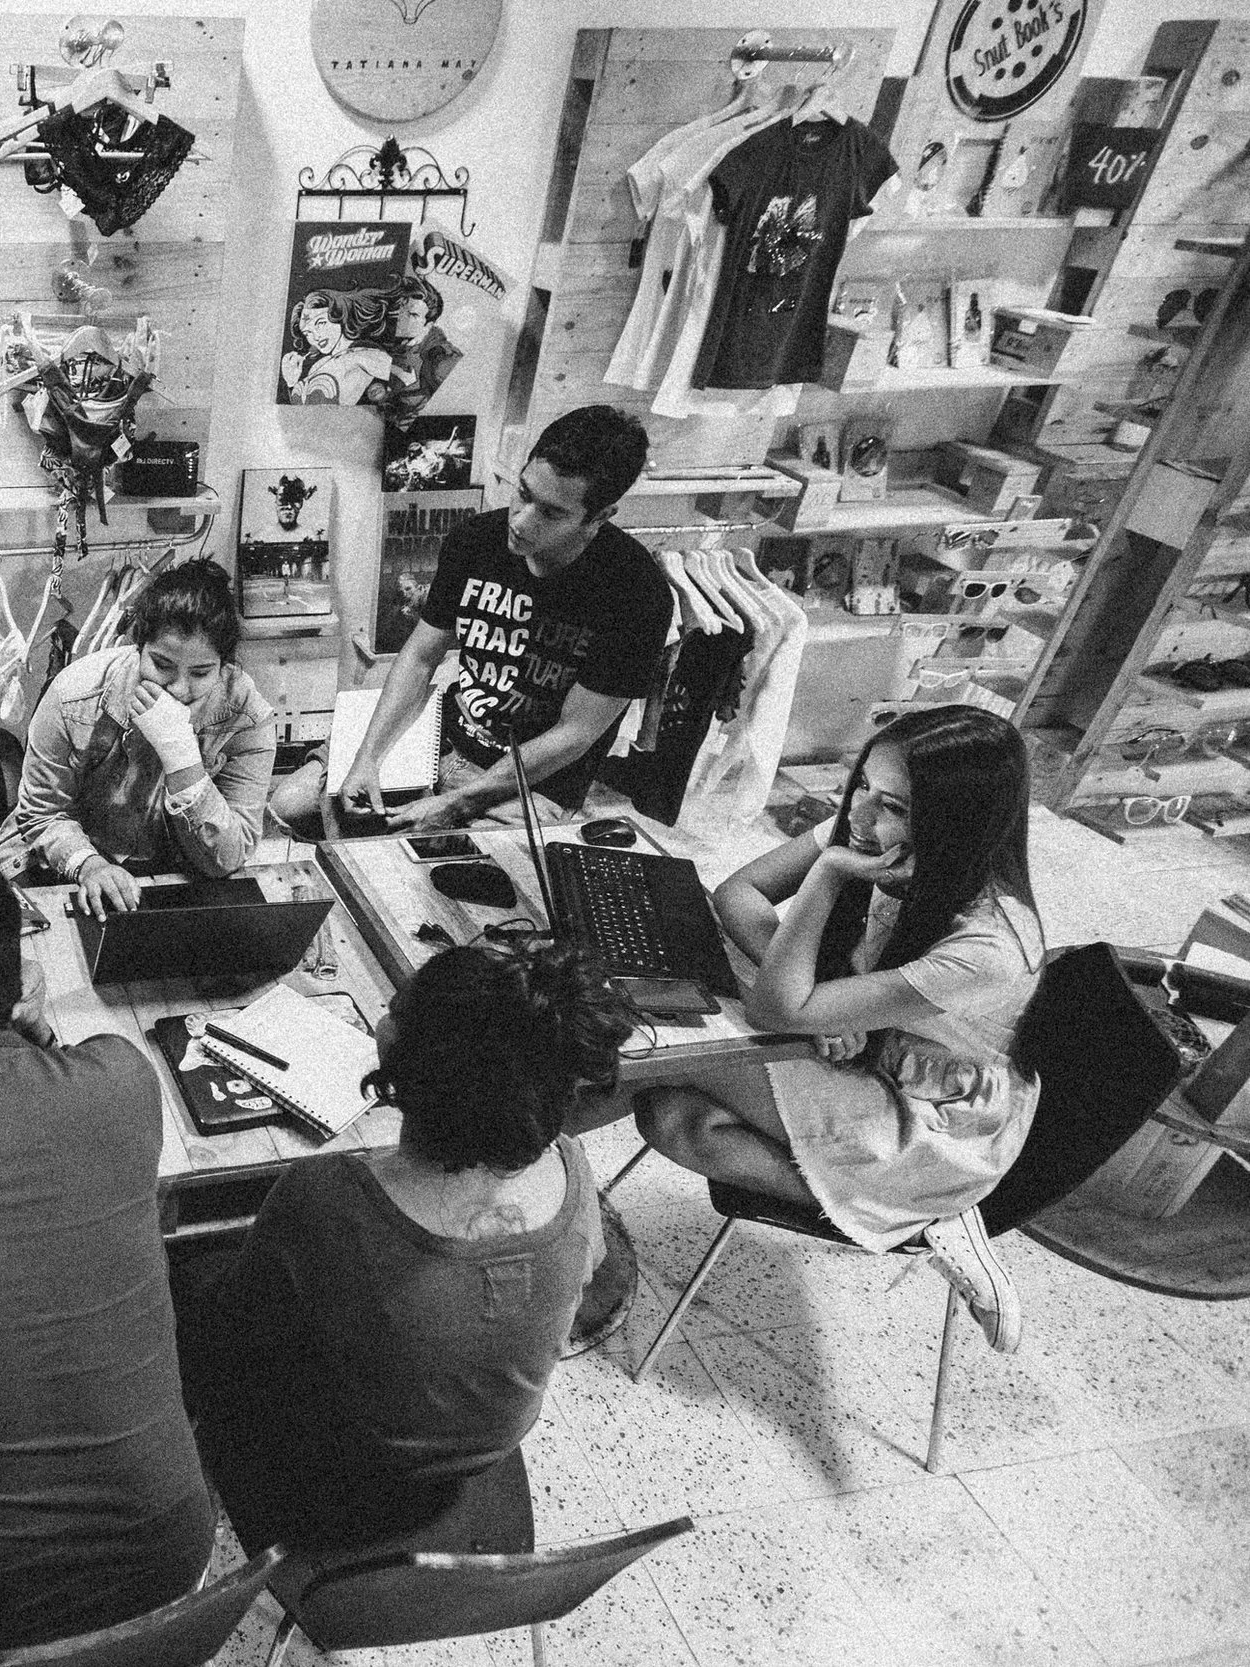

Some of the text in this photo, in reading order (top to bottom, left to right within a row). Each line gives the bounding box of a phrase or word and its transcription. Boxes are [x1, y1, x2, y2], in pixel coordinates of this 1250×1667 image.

[1088, 145, 1147, 185] 40%
[307, 228, 385, 254] Wonder
[323, 243, 397, 269] Woman
[415, 245, 506, 301] SUPERMAN
[459, 577, 533, 622] FRAC
[456, 616, 530, 657] FRAC
